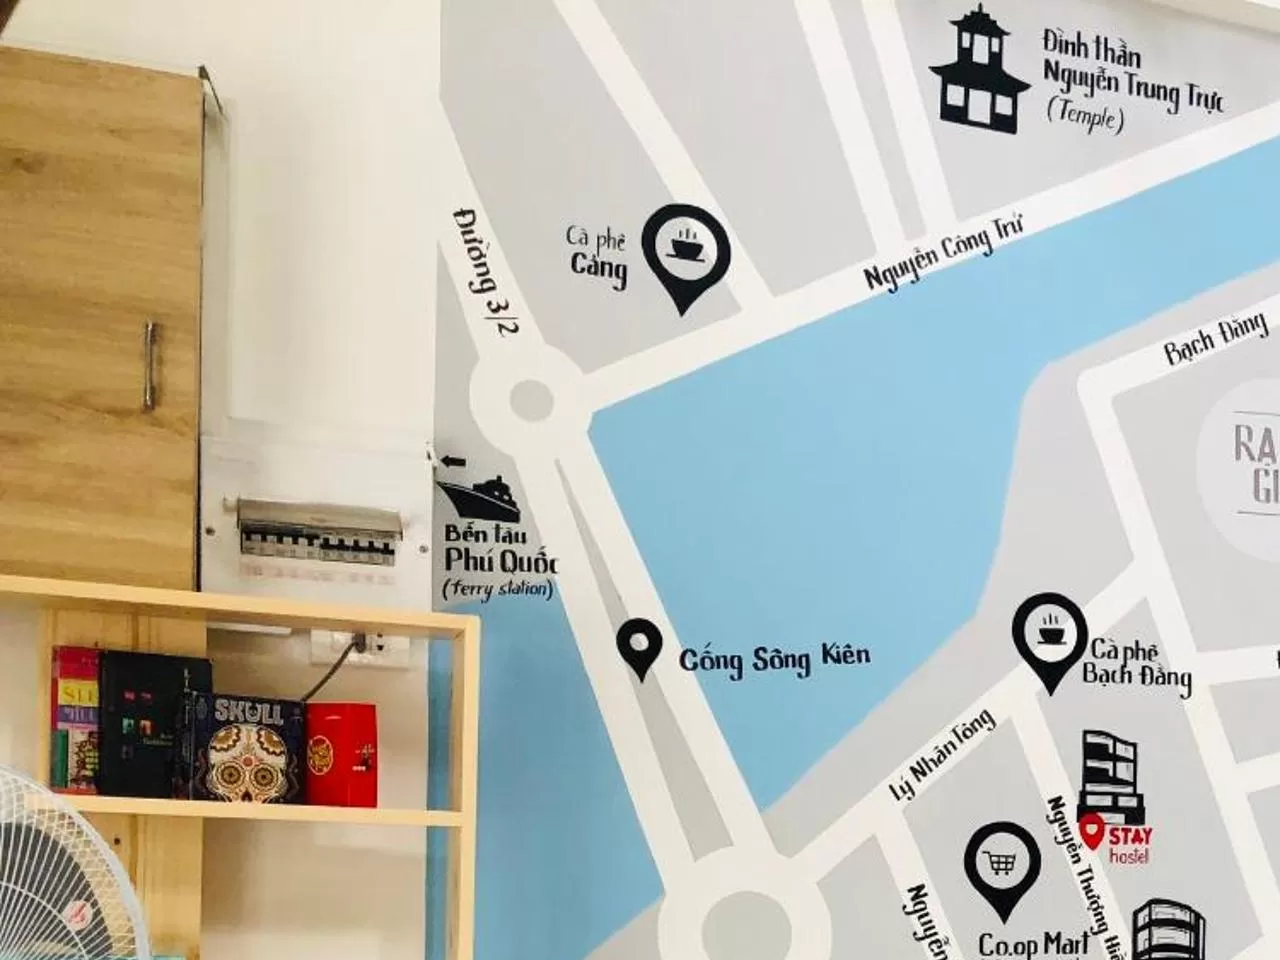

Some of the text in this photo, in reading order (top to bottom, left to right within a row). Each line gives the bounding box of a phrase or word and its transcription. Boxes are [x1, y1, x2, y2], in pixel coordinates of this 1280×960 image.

[1043, 27, 1141, 69] Đình thần
[1043, 58, 1224, 115] Nguyễn Trung Trực
[1047, 95, 1124, 135] (Temple)
[566, 224, 625, 257] Cà phê
[453, 207, 519, 337] Đường 3/2
[864, 247, 939, 294] Nguyễn
[941, 229, 994, 257] Công
[1164, 329, 1215, 366] Bạch
[445, 521, 487, 543] Bến
[445, 545, 560, 575] Phú Quốc
[442, 578, 553, 604] (ferry station)
[679, 641, 871, 681] Cống Sông Kiên
[1091, 637, 1160, 668] Cà phê
[1083, 661, 1132, 687] Bạch
[214, 698, 284, 725] SKULL
[888, 709, 997, 801] Lý Nhân Tông
[1045, 795, 1084, 864] Nguyễn
[1109, 827, 1152, 846] STAY
[1109, 849, 1149, 864] hostel
[1044, 931, 1091, 955] Mart
